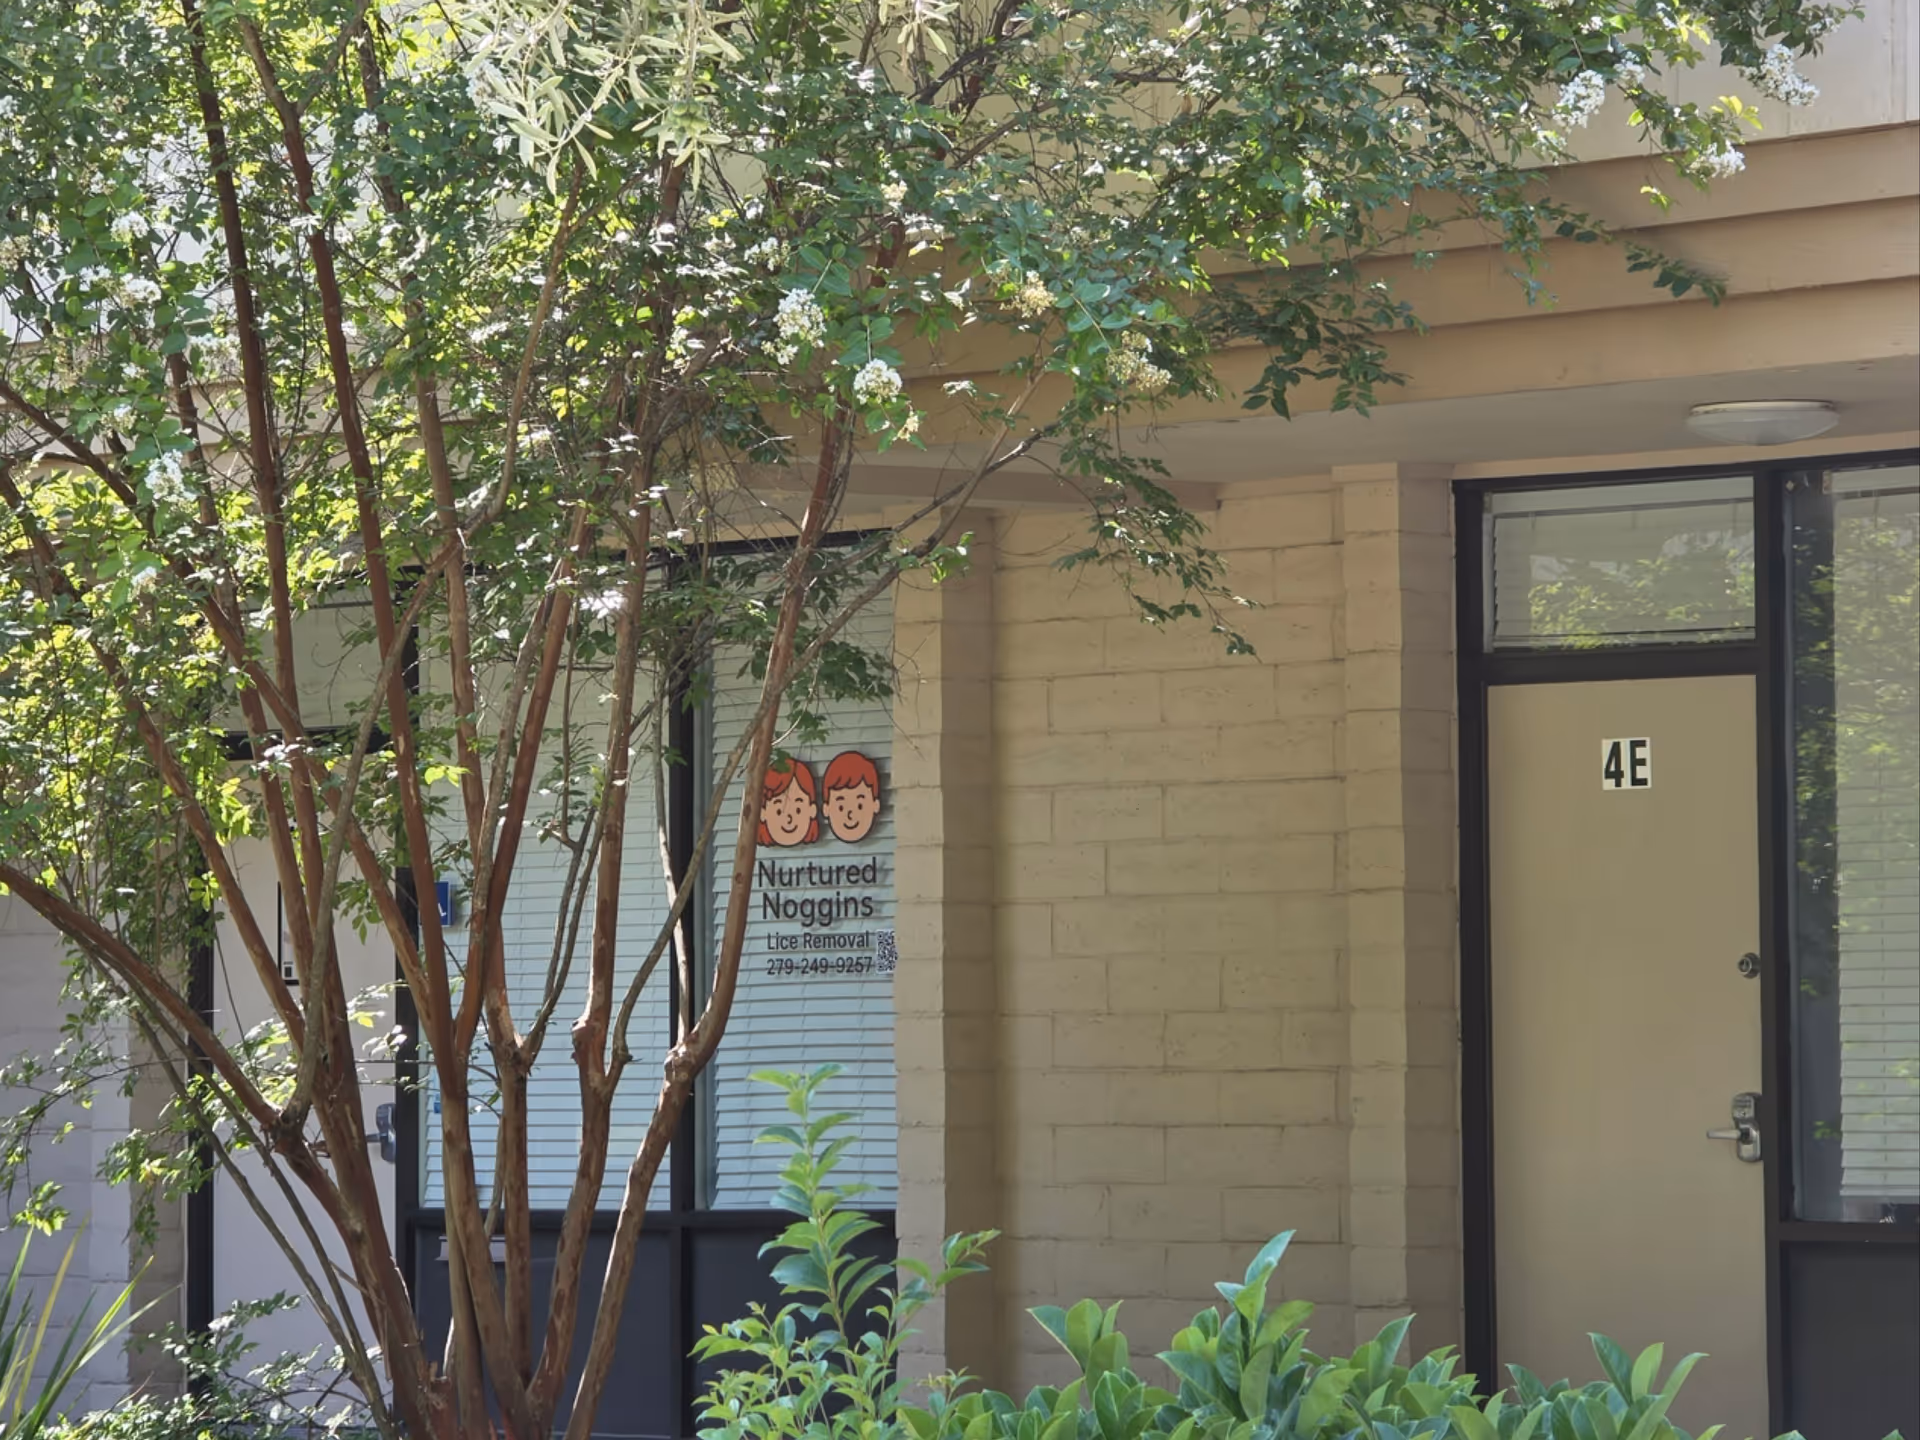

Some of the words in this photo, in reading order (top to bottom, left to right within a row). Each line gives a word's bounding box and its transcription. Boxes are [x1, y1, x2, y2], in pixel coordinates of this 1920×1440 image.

[1604, 740, 1648, 788] 4E
[758, 856, 877, 888] Nurtured
[762, 891, 874, 927] Noggins
[767, 932, 798, 951] Lice
[803, 930, 870, 950] Removal
[766, 956, 873, 975] 279-249-9257
